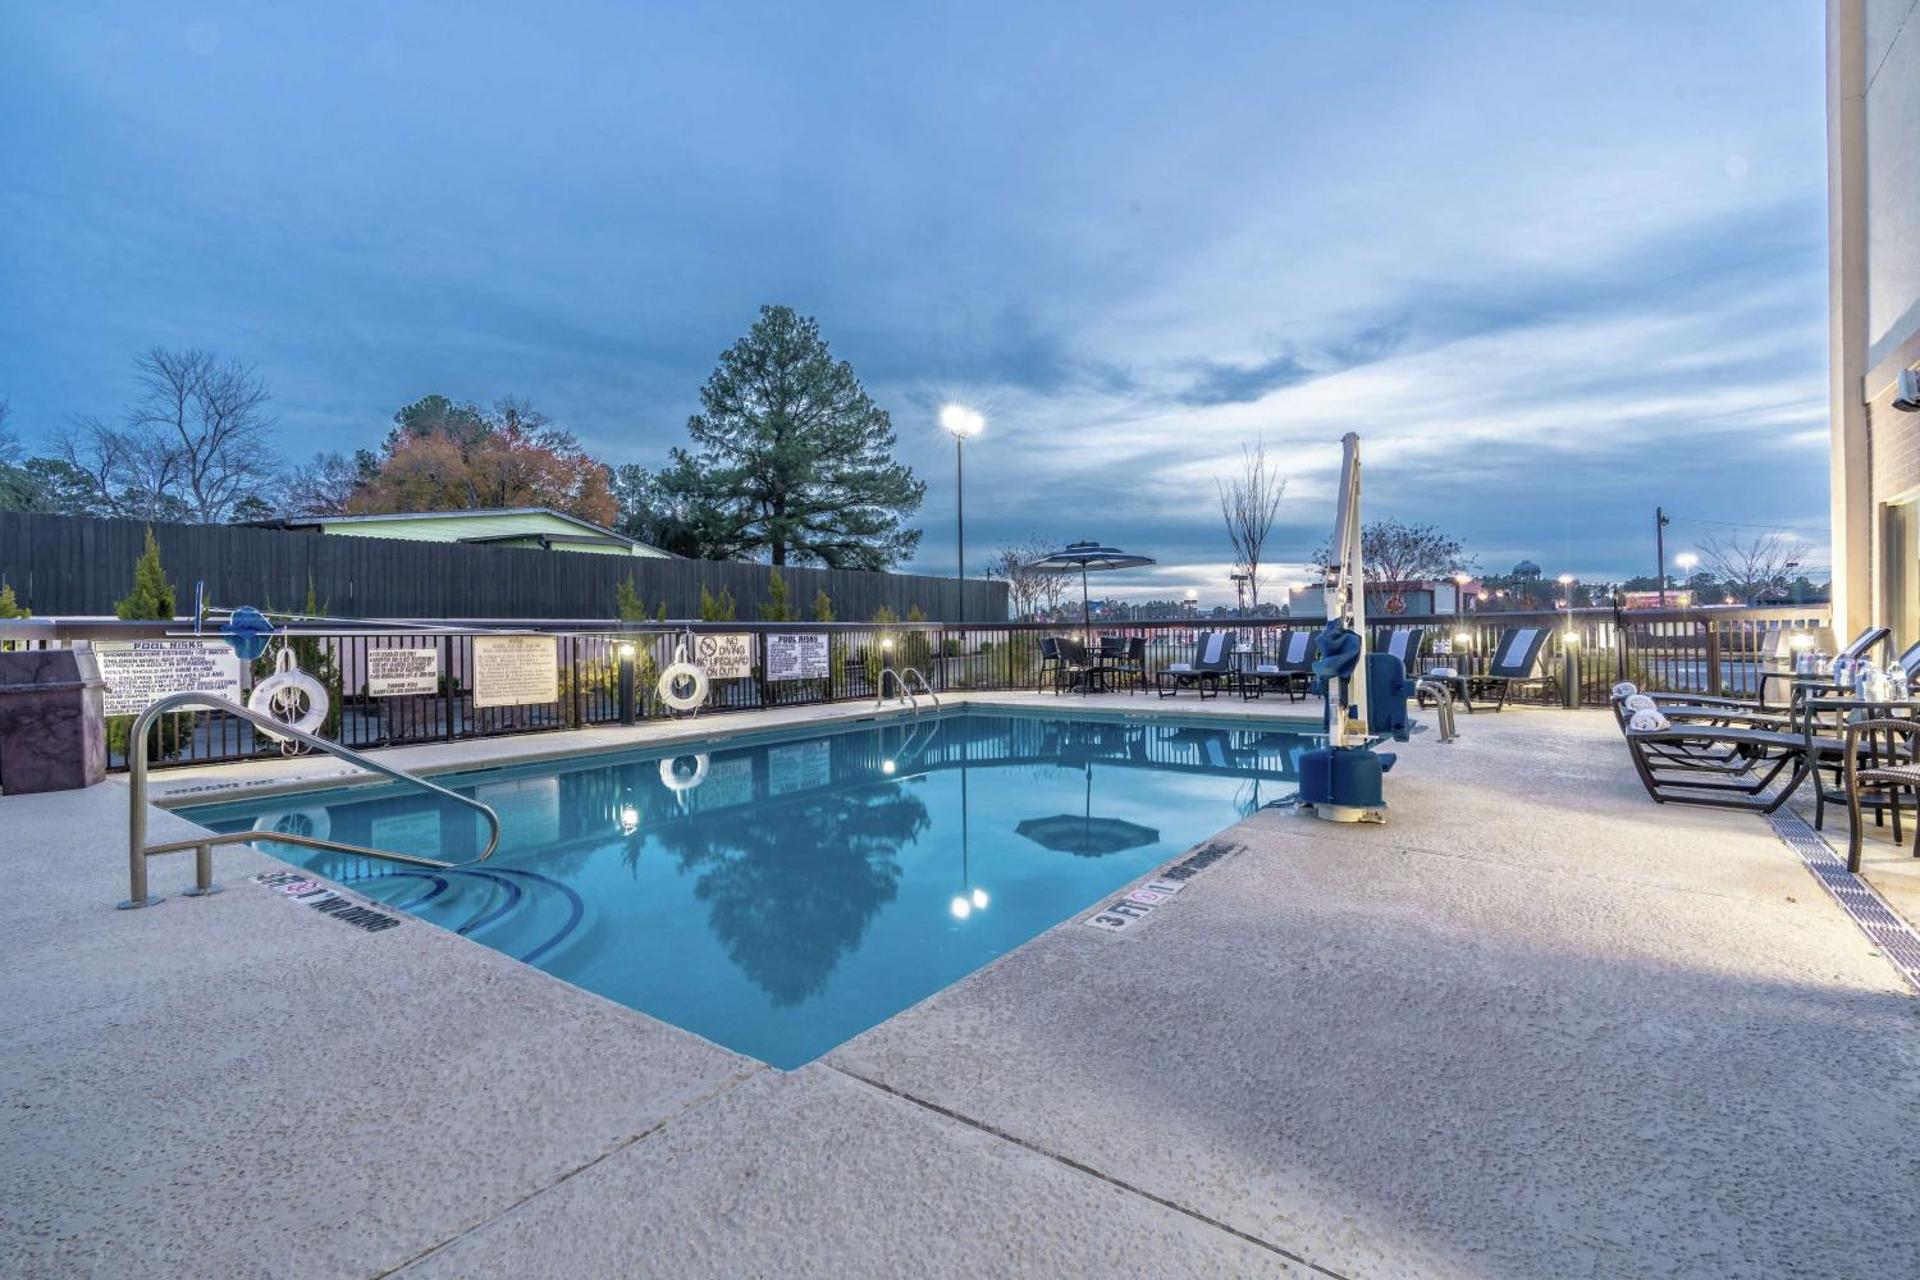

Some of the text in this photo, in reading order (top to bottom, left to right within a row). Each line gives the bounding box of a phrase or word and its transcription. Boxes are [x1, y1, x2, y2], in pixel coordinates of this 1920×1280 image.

[134, 642, 165, 650] POOL
[726, 636, 738, 645] NO
[719, 645, 745, 656] DIVING
[696, 655, 749, 667] NO LIFEGUARD
[706, 666, 740, 677] ON DUTY
[1095, 899, 1151, 927] 3 FT
